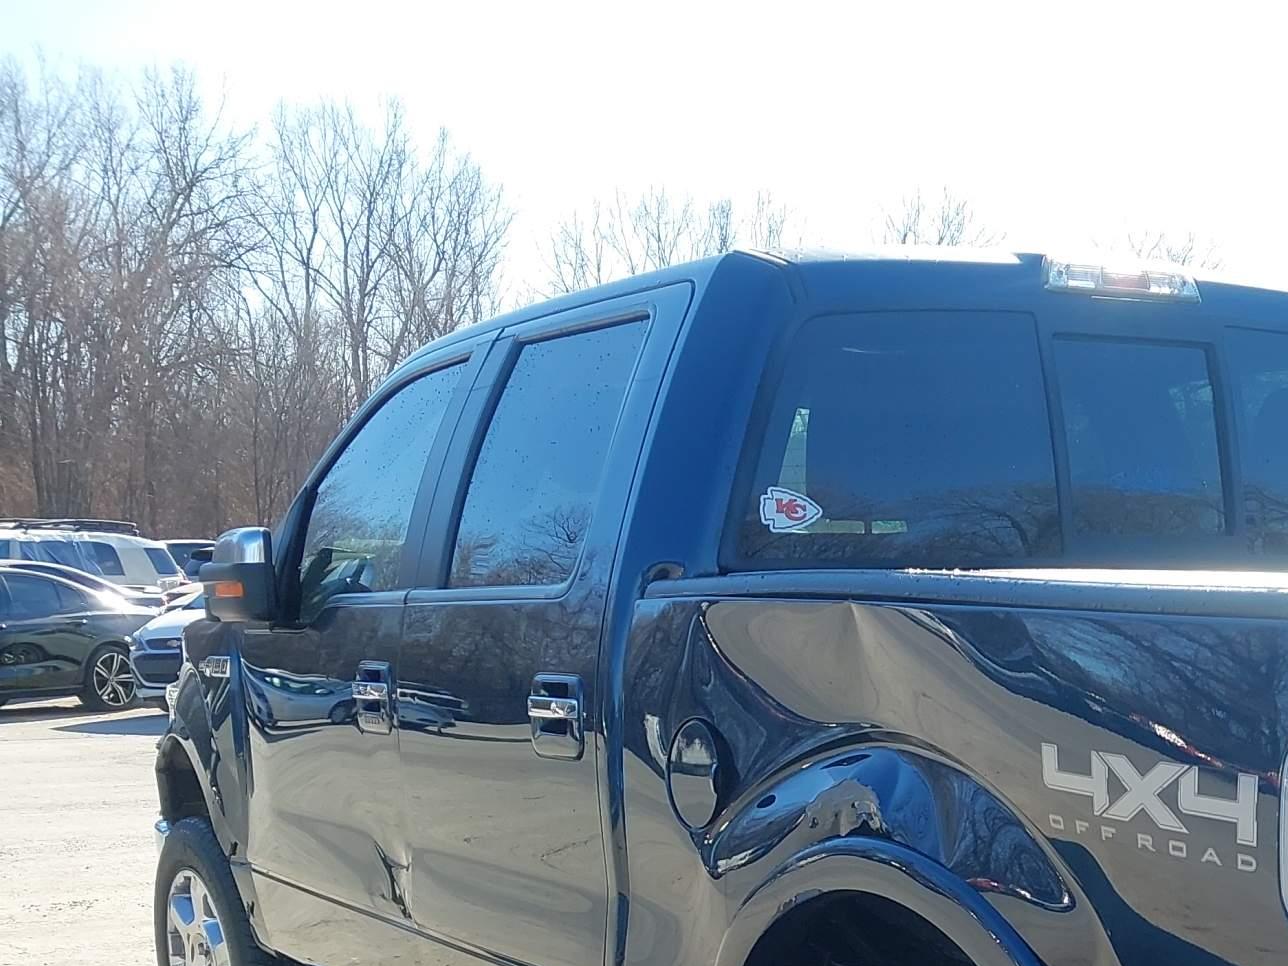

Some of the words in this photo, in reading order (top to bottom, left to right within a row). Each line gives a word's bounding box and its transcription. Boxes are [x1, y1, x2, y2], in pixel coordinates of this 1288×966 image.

[775, 498, 807, 522] KC
[1048, 813, 1117, 841] OFF
[1137, 833, 1258, 873] ROAD
